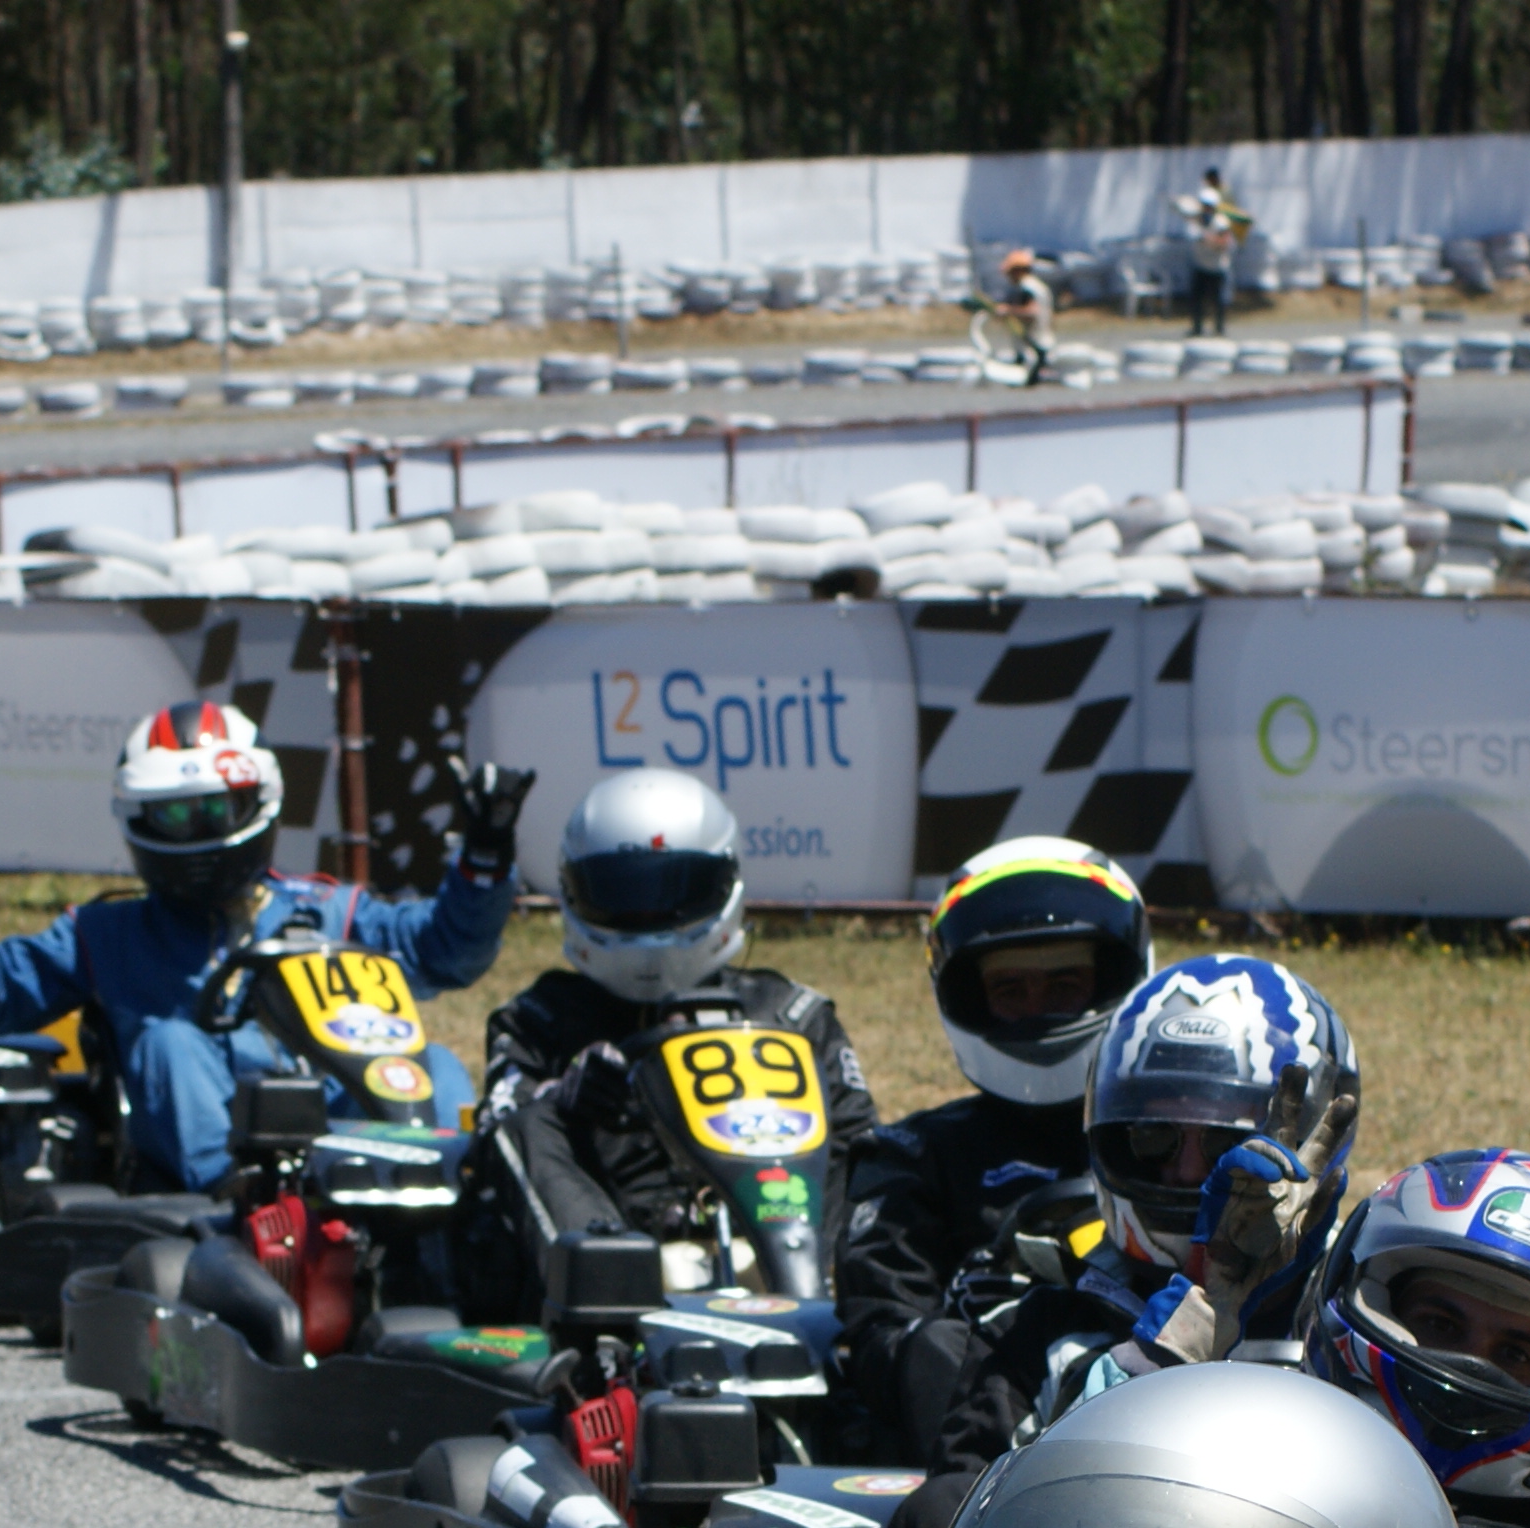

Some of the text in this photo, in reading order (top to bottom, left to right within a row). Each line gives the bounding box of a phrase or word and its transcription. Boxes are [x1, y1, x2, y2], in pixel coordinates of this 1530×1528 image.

[660, 668, 851, 792] Spirit
[301, 956, 401, 1014] 143
[682, 1037, 808, 1106] 89
